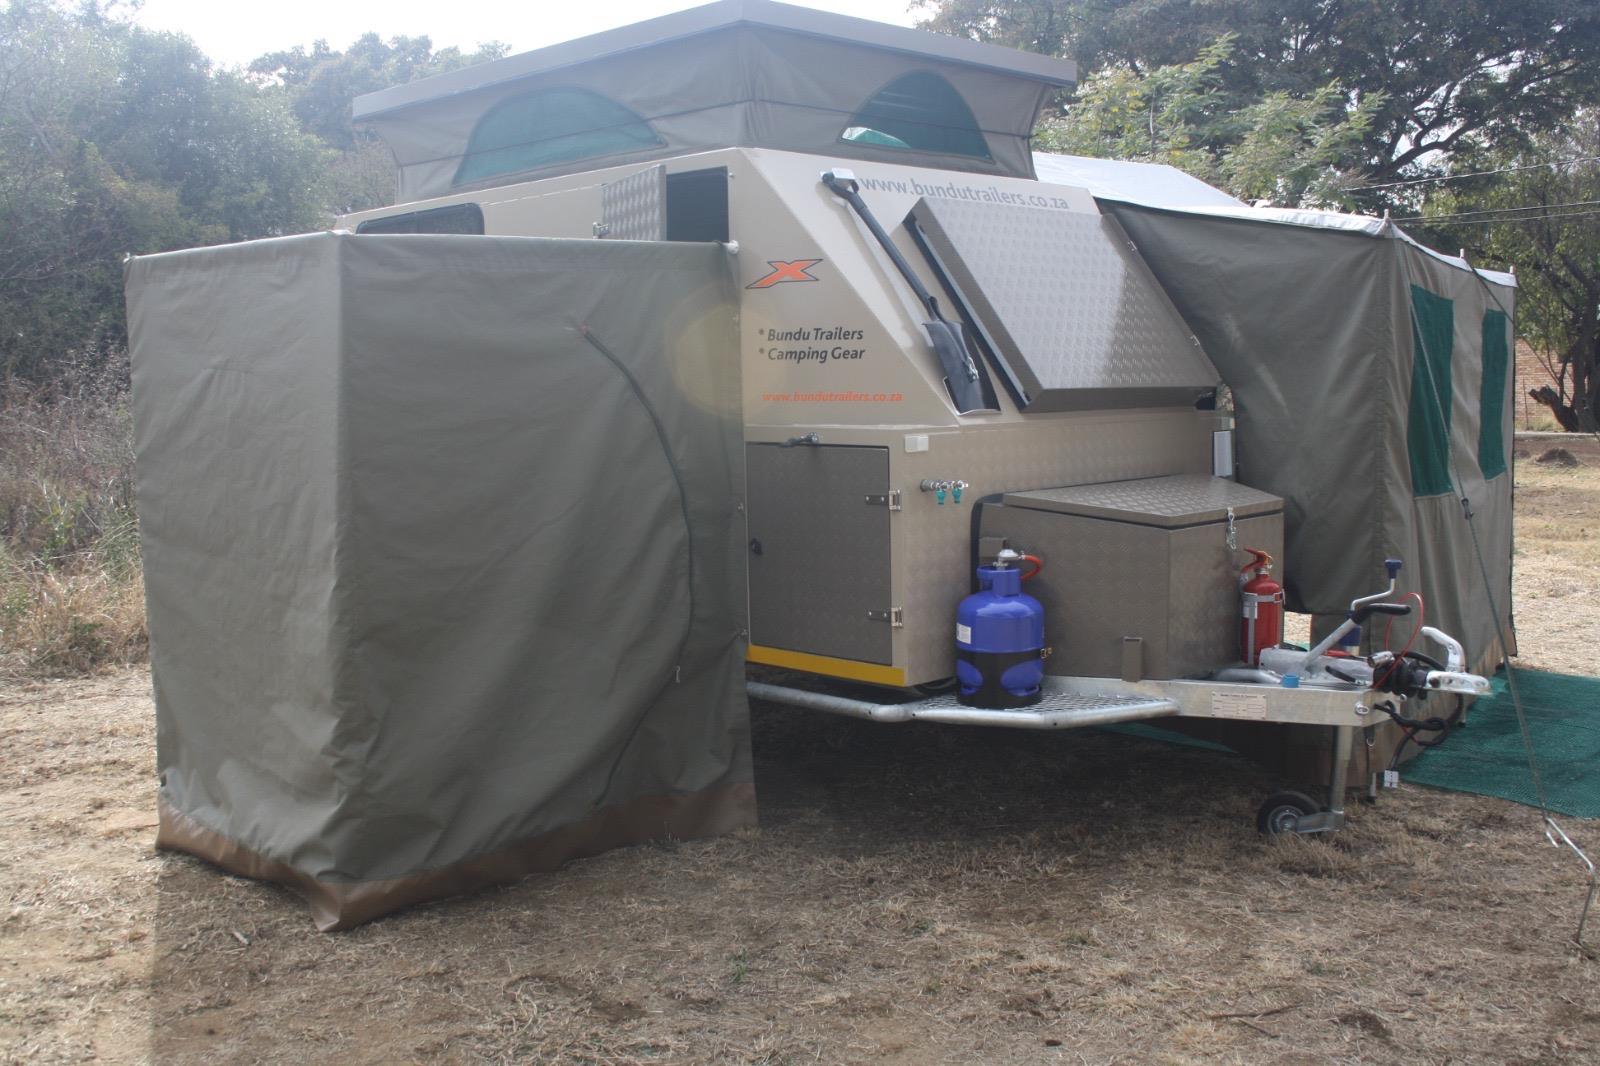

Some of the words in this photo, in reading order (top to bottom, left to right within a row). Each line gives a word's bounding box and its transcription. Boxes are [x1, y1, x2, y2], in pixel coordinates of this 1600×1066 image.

[861, 176, 1068, 209] www.bundutrailers.co.za
[768, 328, 810, 341] Bundu
[814, 327, 863, 340] Trailers
[768, 347, 828, 364] Camping
[832, 347, 866, 360] Gear
[763, 391, 903, 402] www.bundutrailers.co.za
